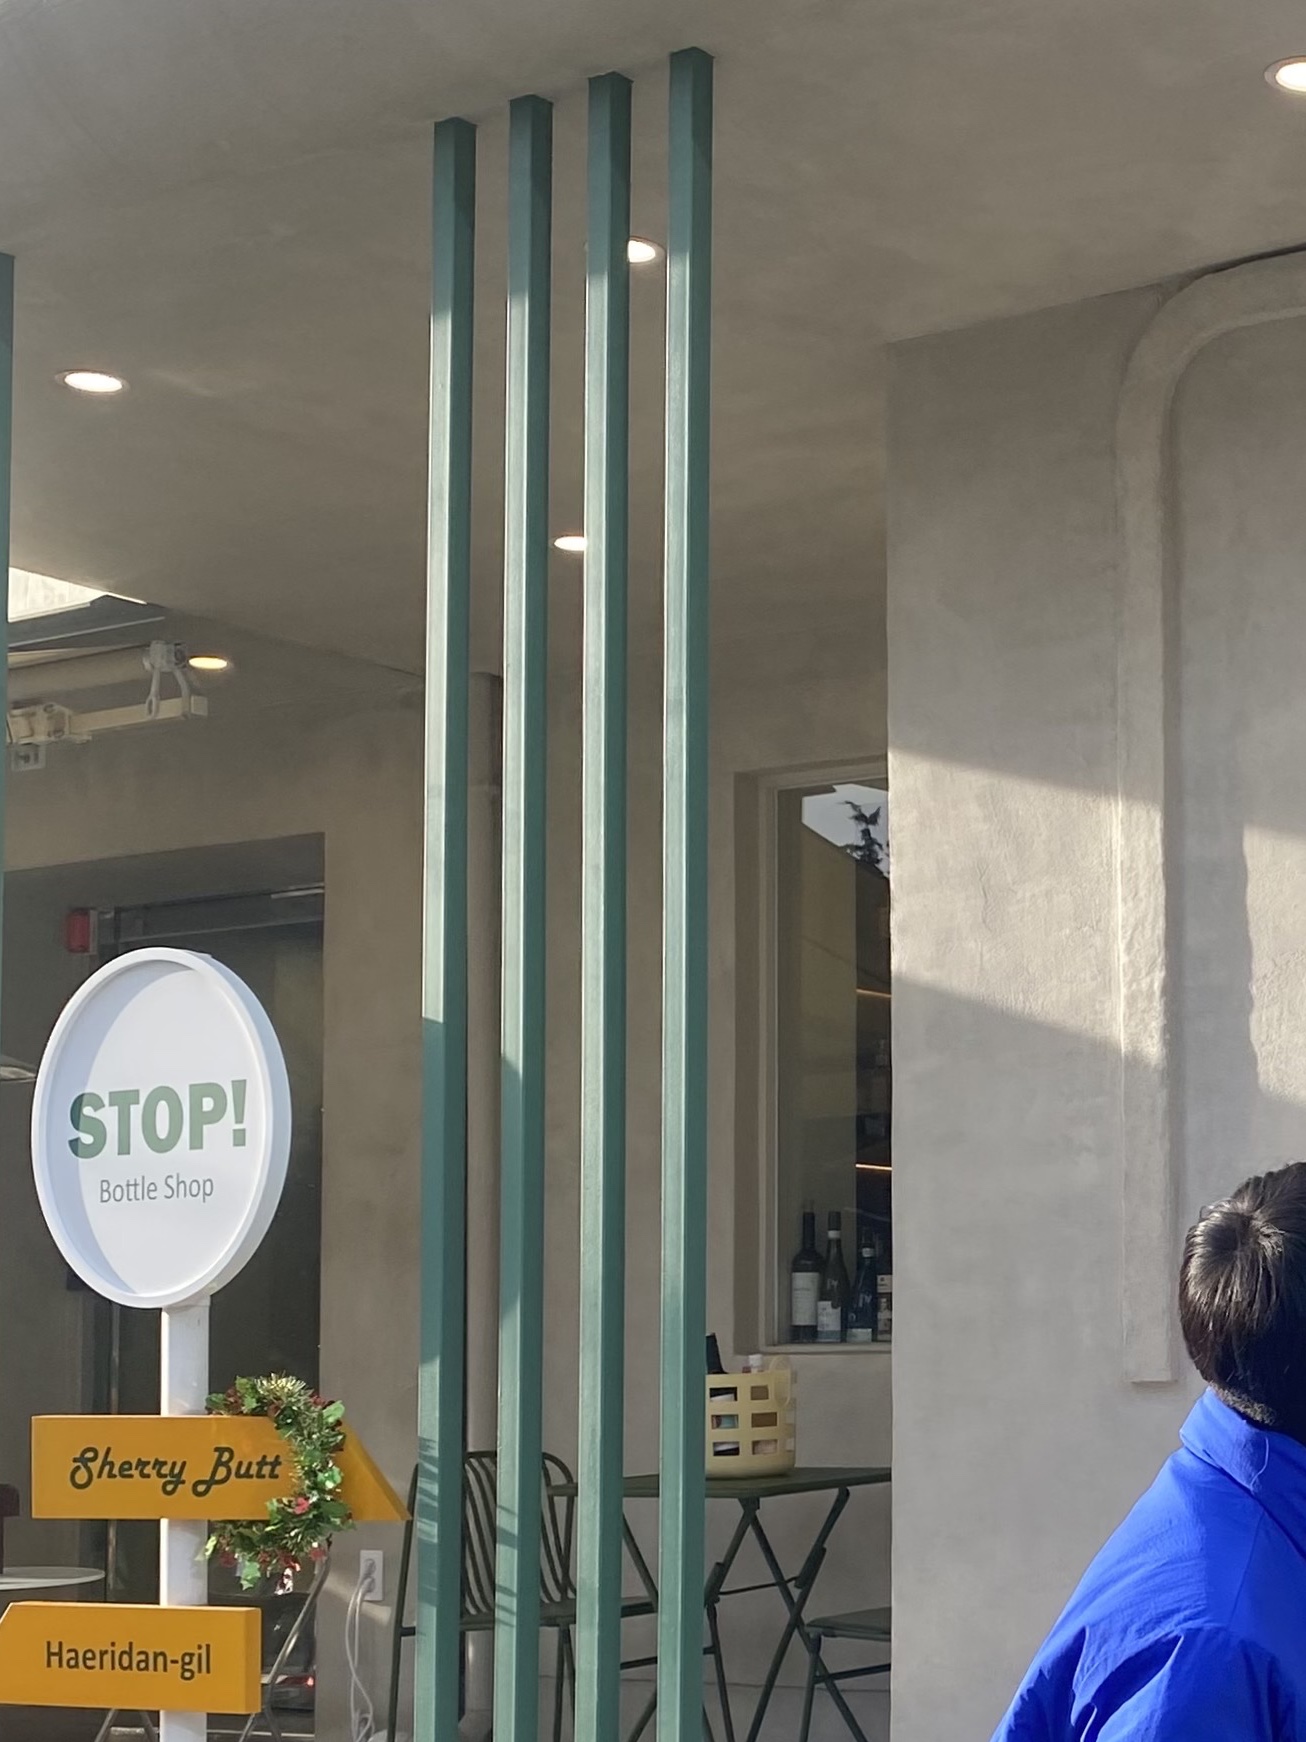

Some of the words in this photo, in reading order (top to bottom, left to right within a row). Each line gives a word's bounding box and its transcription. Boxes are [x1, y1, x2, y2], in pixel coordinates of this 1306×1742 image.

[68, 1079, 247, 1159] STOP!
[99, 1175, 158, 1203] Bottle
[164, 1173, 214, 1203] Shop
[69, 1446, 187, 1496] Sherry
[192, 1446, 281, 1497] Butt
[45, 1640, 211, 1681] Haeridan-gil
